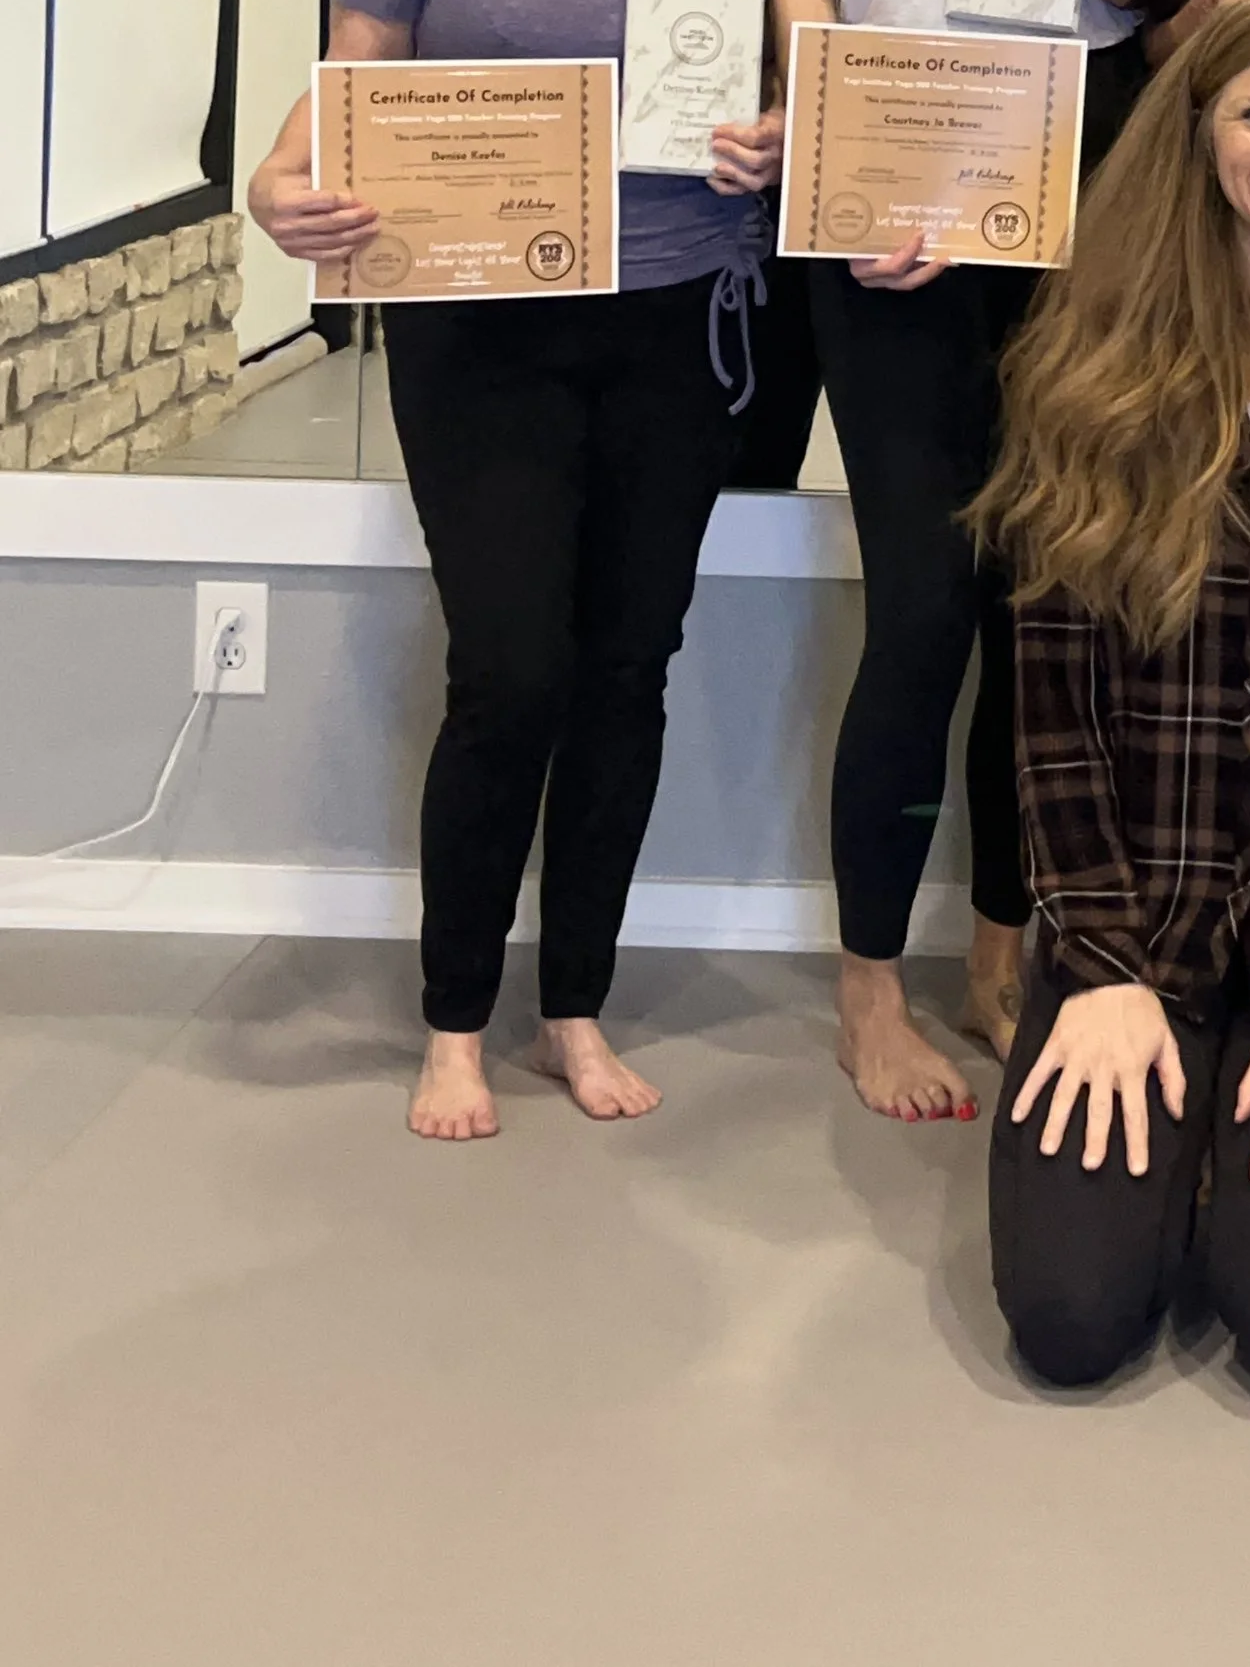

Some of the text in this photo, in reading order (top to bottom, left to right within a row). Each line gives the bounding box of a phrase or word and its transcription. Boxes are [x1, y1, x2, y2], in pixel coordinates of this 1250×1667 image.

[844, 53, 1031, 77] Certificate Of Completion
[370, 88, 564, 105] Certificate Of Completion
[884, 114, 930, 127] Courtney
[431, 150, 467, 161] Denise
[994, 213, 1019, 226] RYS
[994, 224, 1016, 234] 200
[538, 243, 563, 254] RYS
[540, 253, 561, 263] 200
